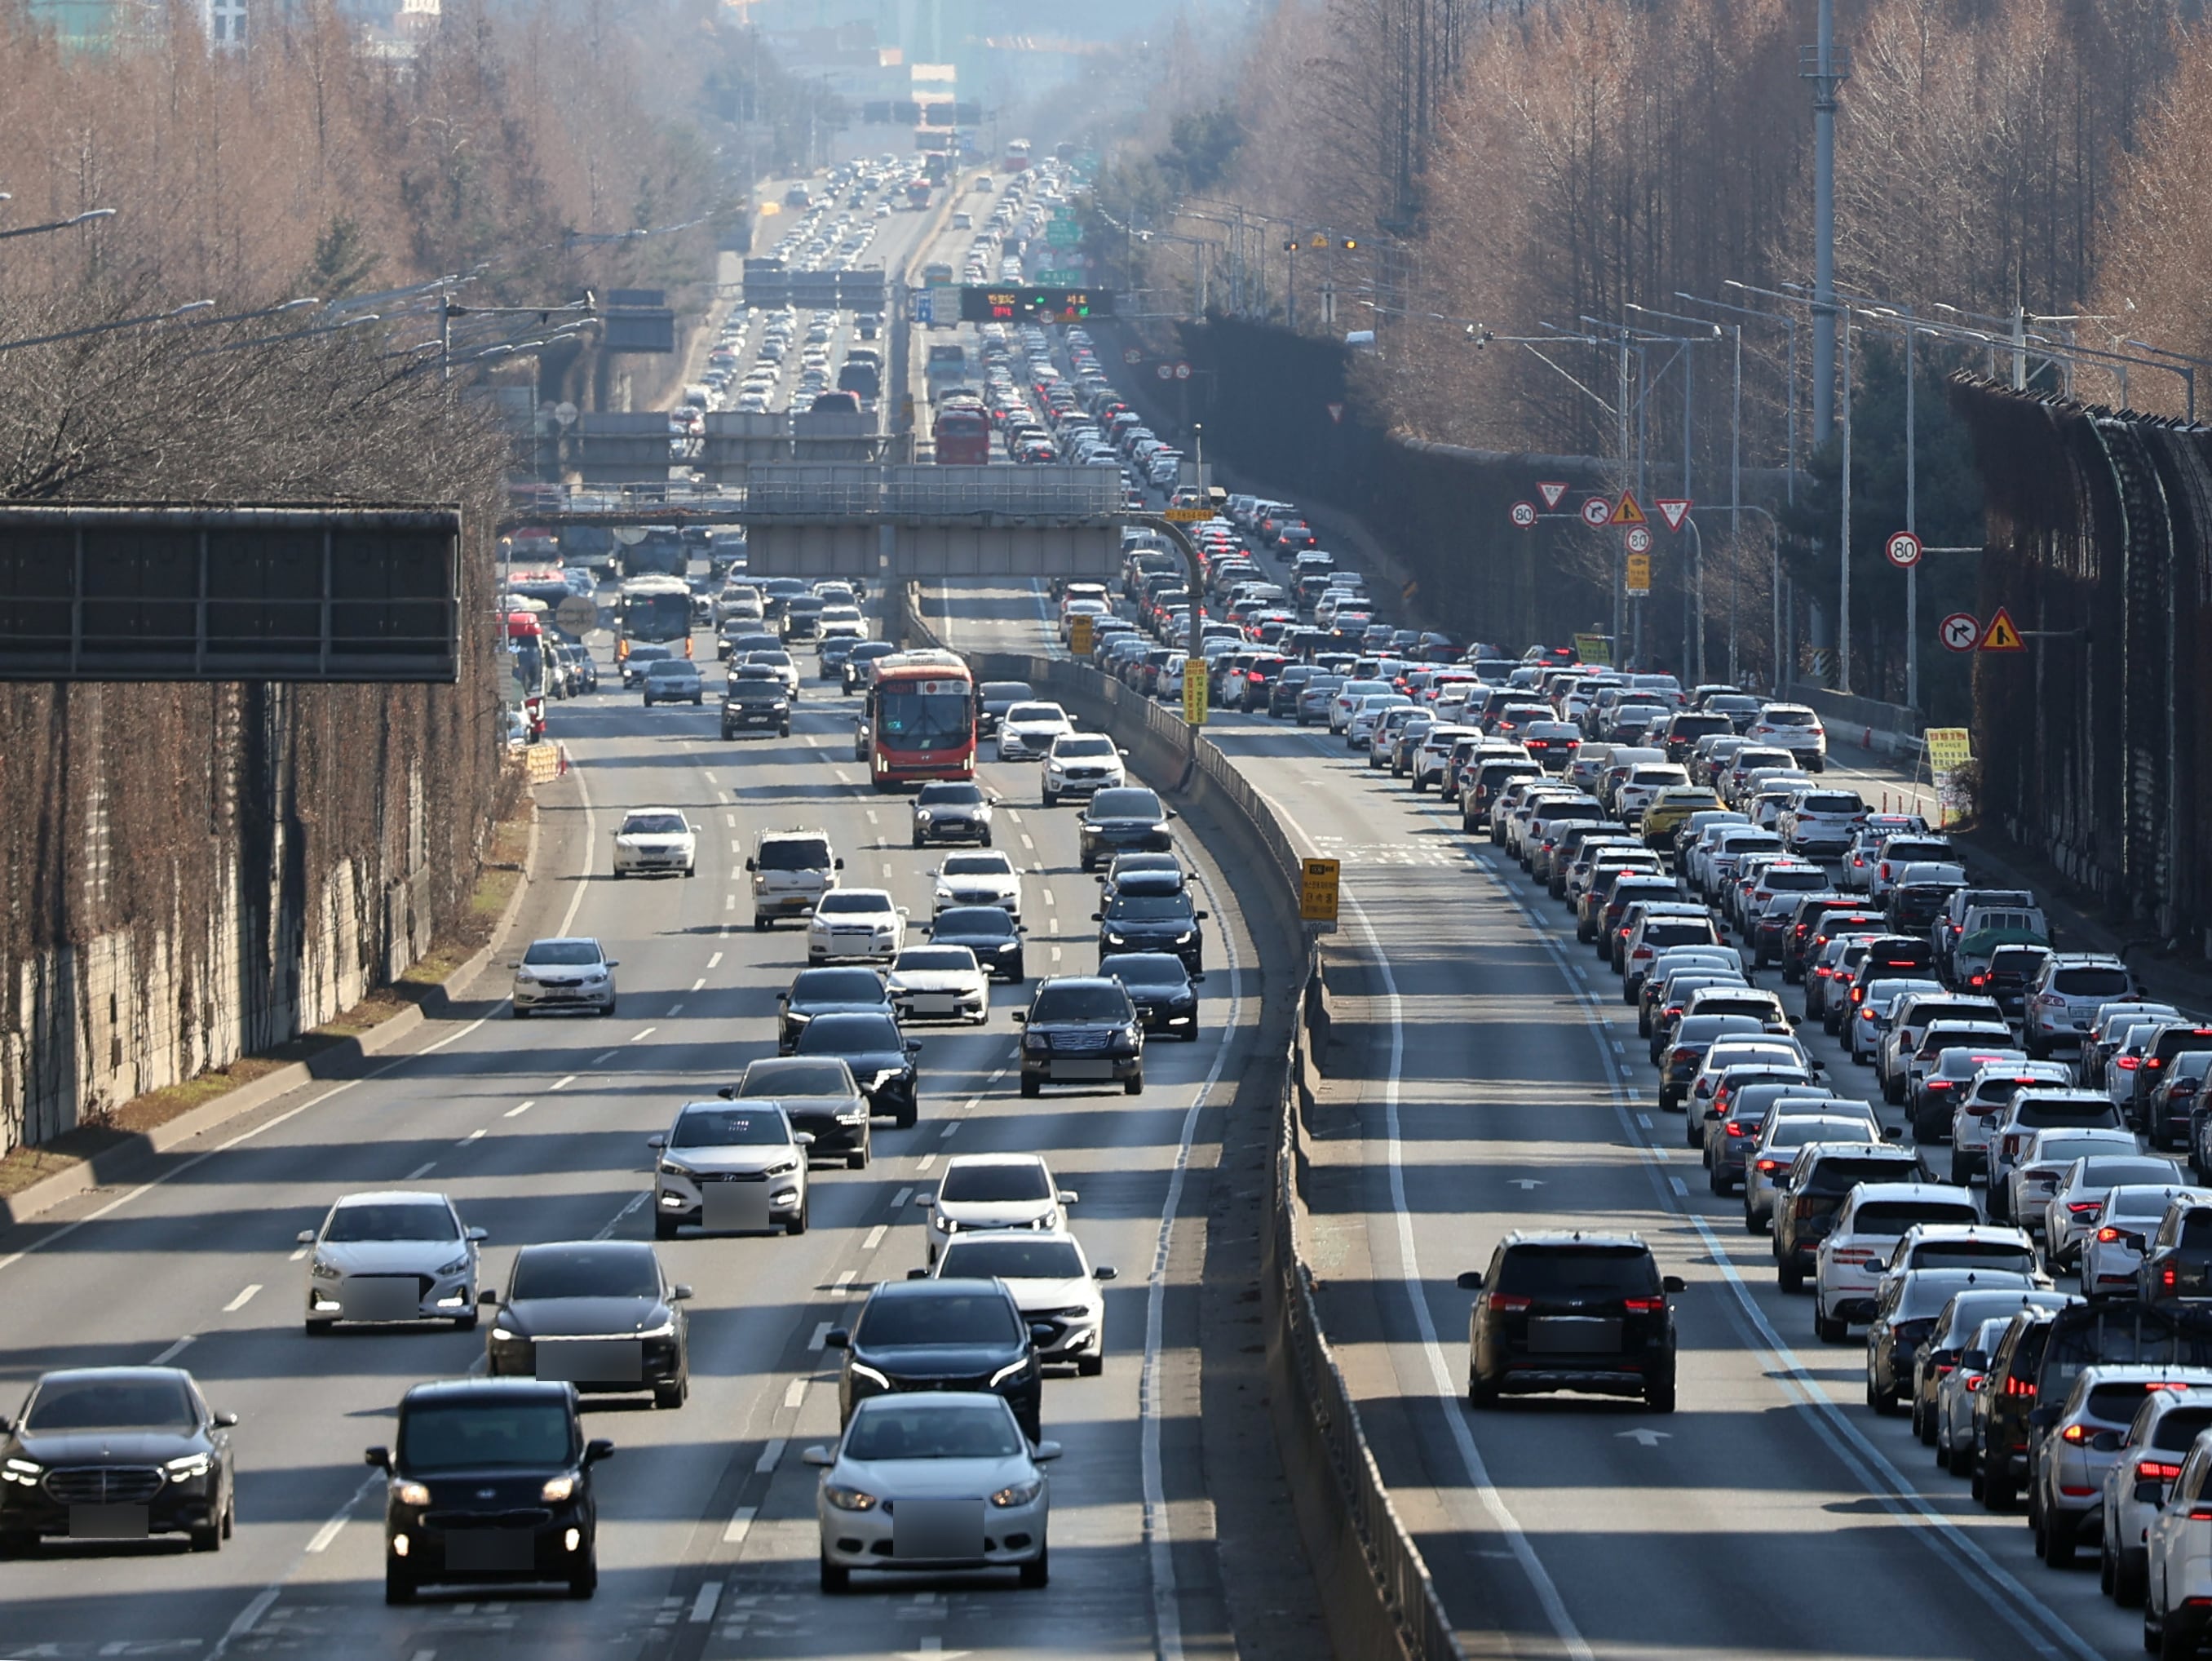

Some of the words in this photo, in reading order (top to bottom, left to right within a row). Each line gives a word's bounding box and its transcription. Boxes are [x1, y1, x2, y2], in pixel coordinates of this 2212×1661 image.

[1515, 508, 1532, 521] 80
[1631, 534, 1647, 547] 80
[1894, 541, 1915, 558] 80
